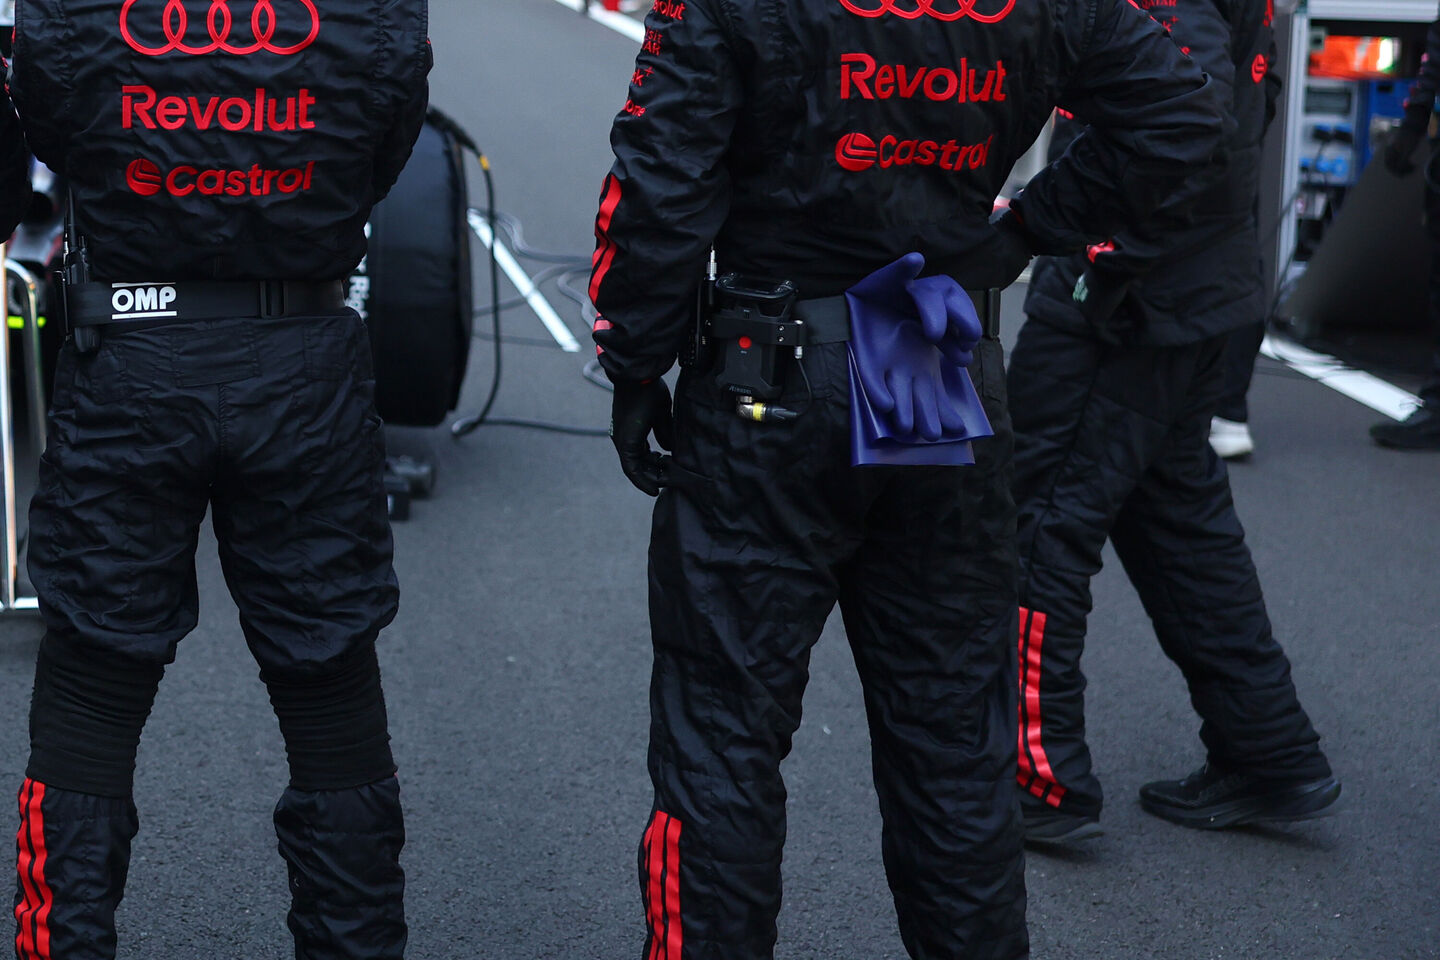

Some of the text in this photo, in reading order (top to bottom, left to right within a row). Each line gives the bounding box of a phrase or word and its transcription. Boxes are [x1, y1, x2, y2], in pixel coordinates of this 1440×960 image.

[840, 53, 1006, 103] Revolut
[121, 85, 316, 131] Revolut
[879, 134, 994, 171] Castrol
[165, 160, 315, 197] Castrol
[112, 286, 177, 313] OMP
